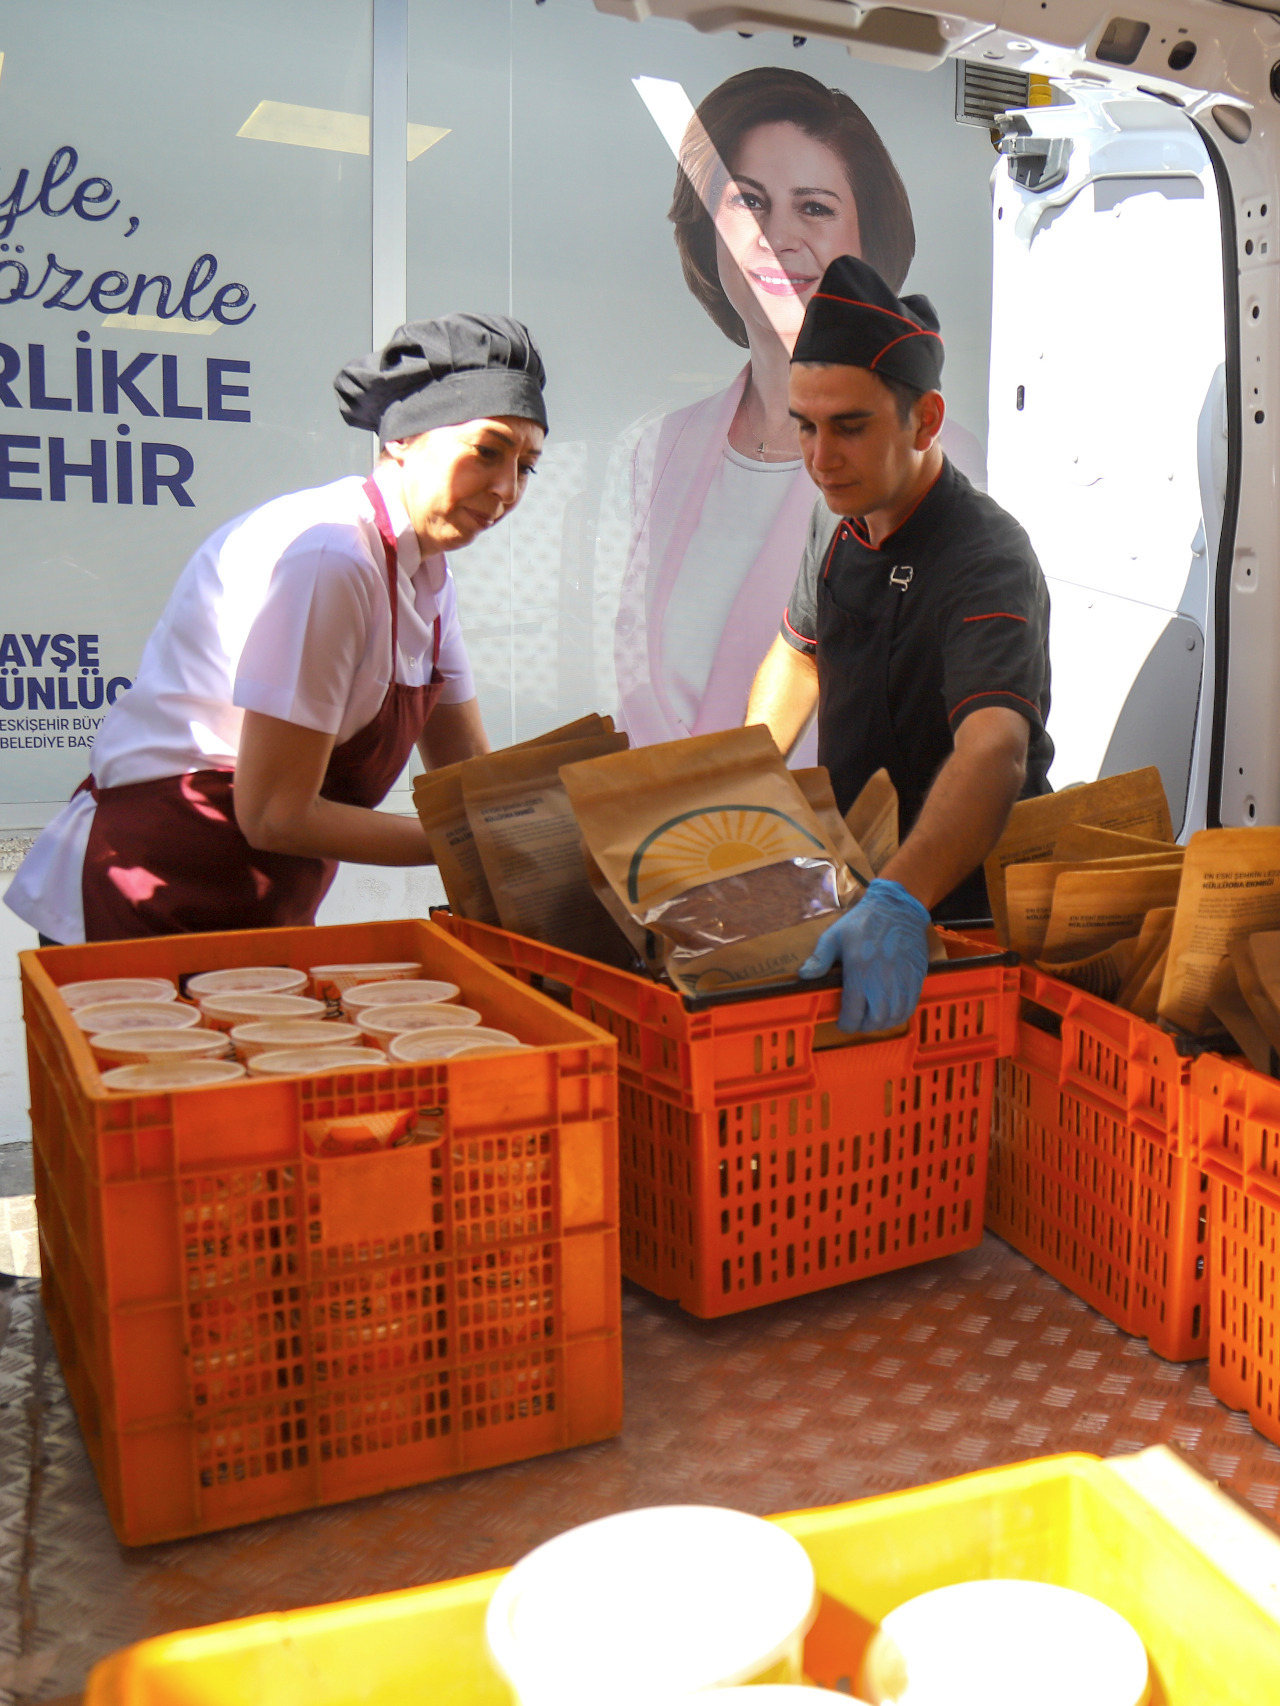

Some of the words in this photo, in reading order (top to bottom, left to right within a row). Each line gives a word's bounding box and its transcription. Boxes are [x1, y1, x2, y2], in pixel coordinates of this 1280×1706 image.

[0, 243, 257, 325] özenle
[0, 423, 196, 508] EHİR
[0, 633, 100, 673] AYŞE
[0, 667, 134, 711] ÜNLÜC
[0, 716, 69, 733] ESKİŞEHİR
[0, 734, 64, 749] BELEDİYE
